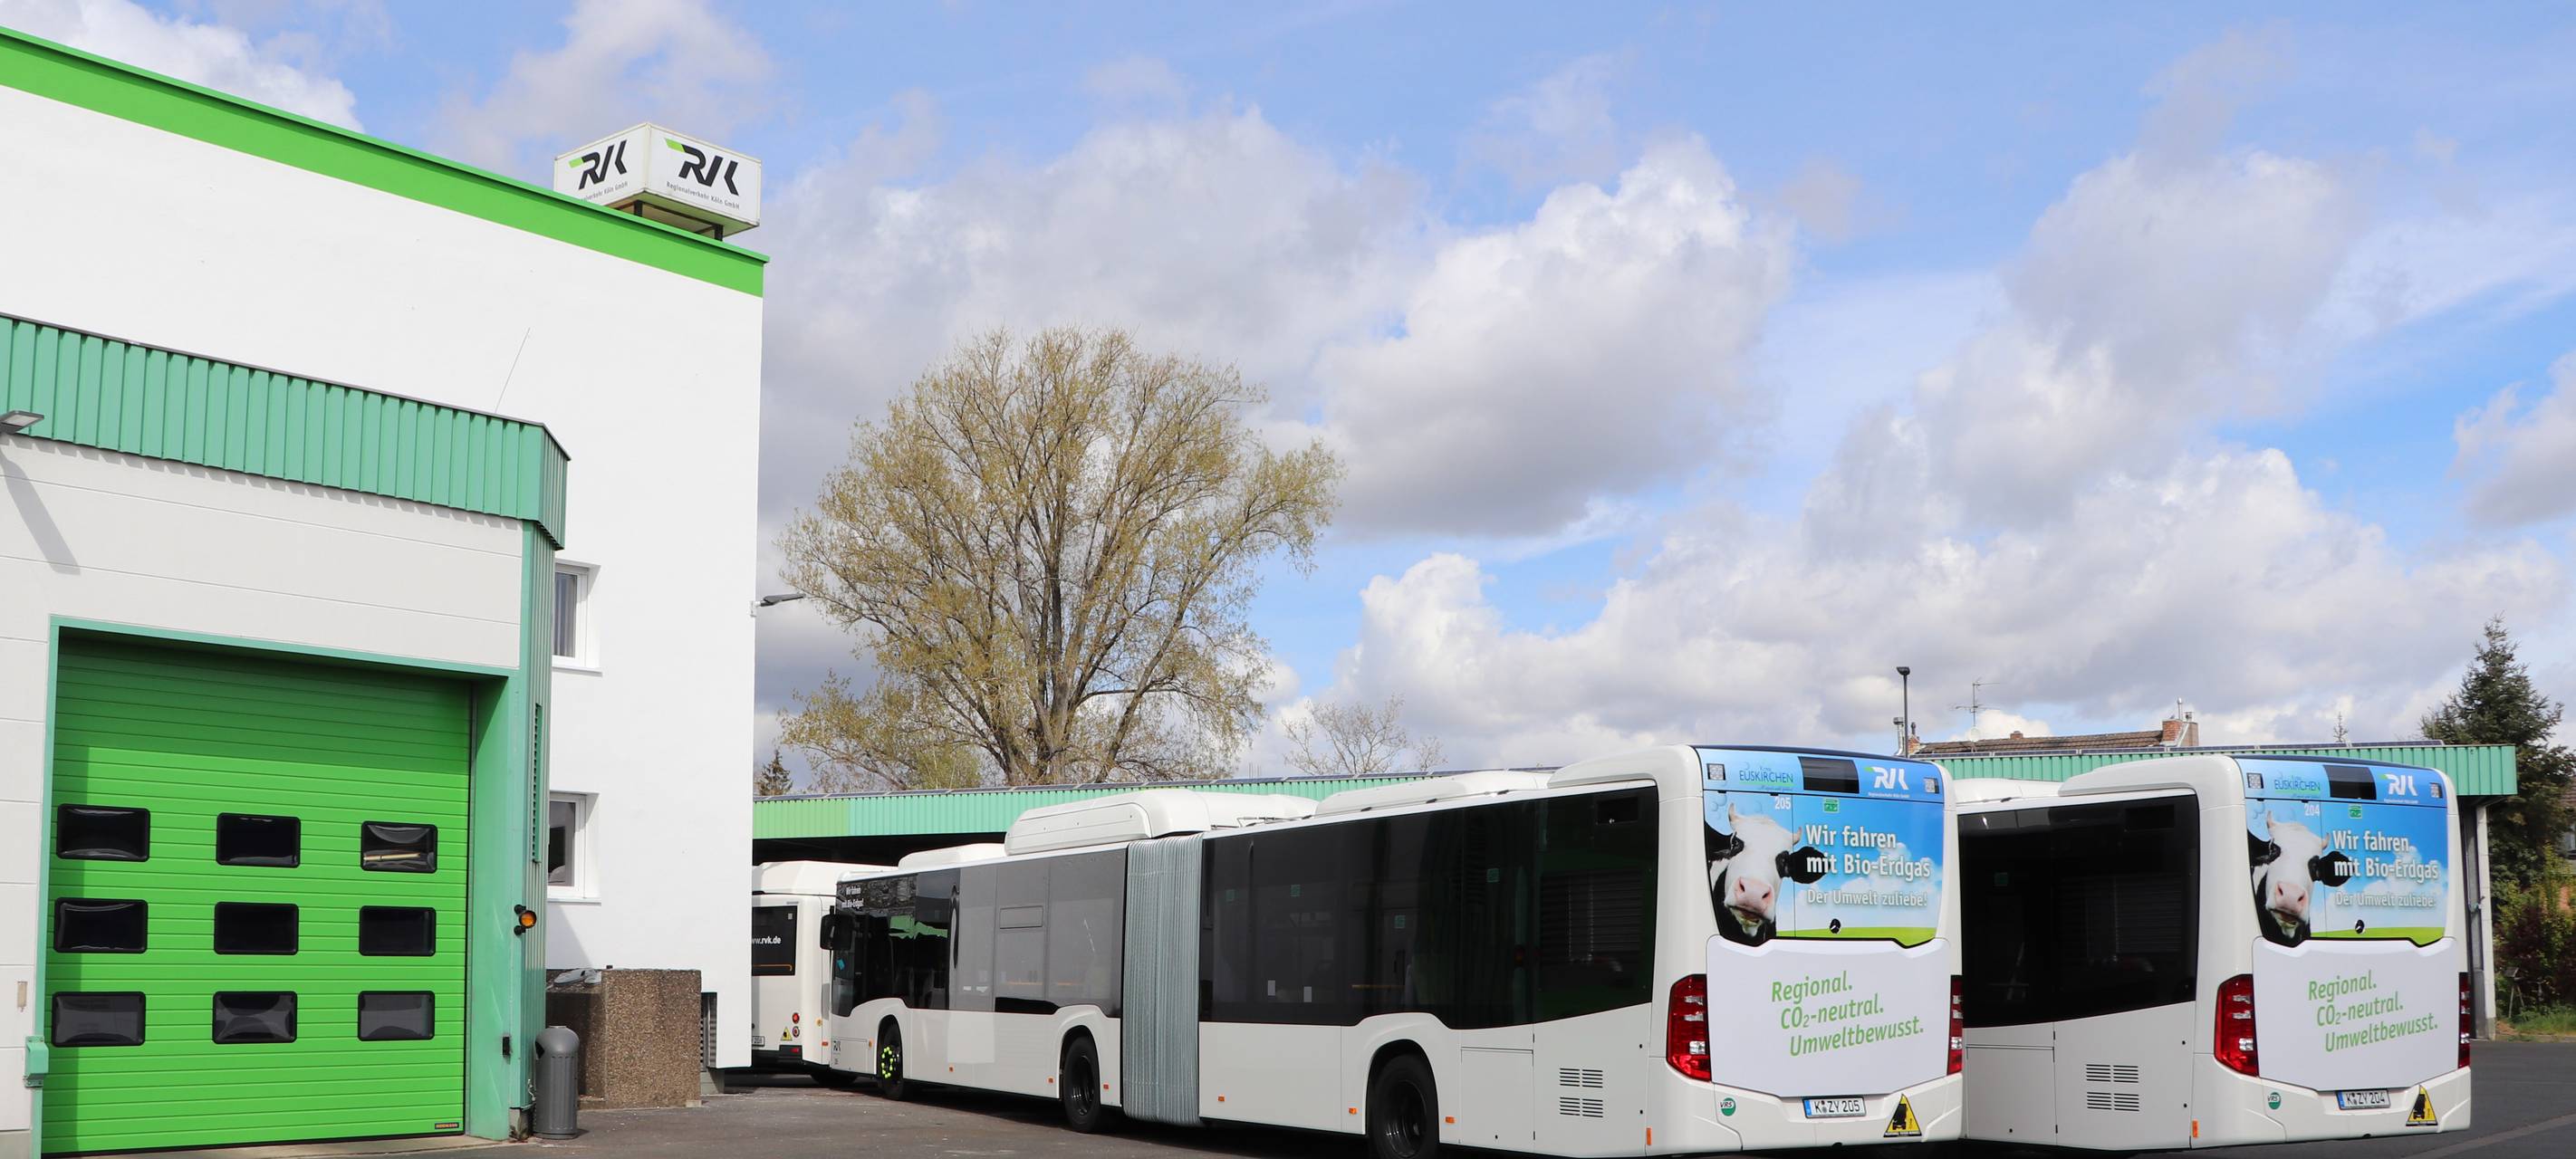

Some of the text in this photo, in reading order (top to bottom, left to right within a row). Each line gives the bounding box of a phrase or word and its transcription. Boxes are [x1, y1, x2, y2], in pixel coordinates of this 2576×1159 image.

[1738, 770, 1794, 784] EUSKIRCHEN
[2273, 779, 2321, 791] EUSKIRCHEN
[1774, 796, 1792, 810] 205
[2303, 802, 2321, 817] 204
[1805, 824, 1897, 848] Wir fahren
[2332, 830, 2409, 851] Wir fahren
[1806, 852, 1931, 882] mit Bio-Erdgas
[2333, 856, 2439, 885] mit Bio-Erdgas
[1806, 889, 1928, 906] Der Umwelt zuliebe!
[2335, 891, 2354, 905] Der
[2357, 892, 2397, 906] Umwelt
[1772, 970, 1853, 1004] Regional.
[2308, 970, 2378, 1002] Regional.
[1790, 1016, 1925, 1057] Umweltbewusst.
[2324, 1012, 2439, 1053] Umweltbewusst.
[1814, 1099, 1861, 1114] K ZY 205
[2346, 1091, 2386, 1106] K ZY 204
